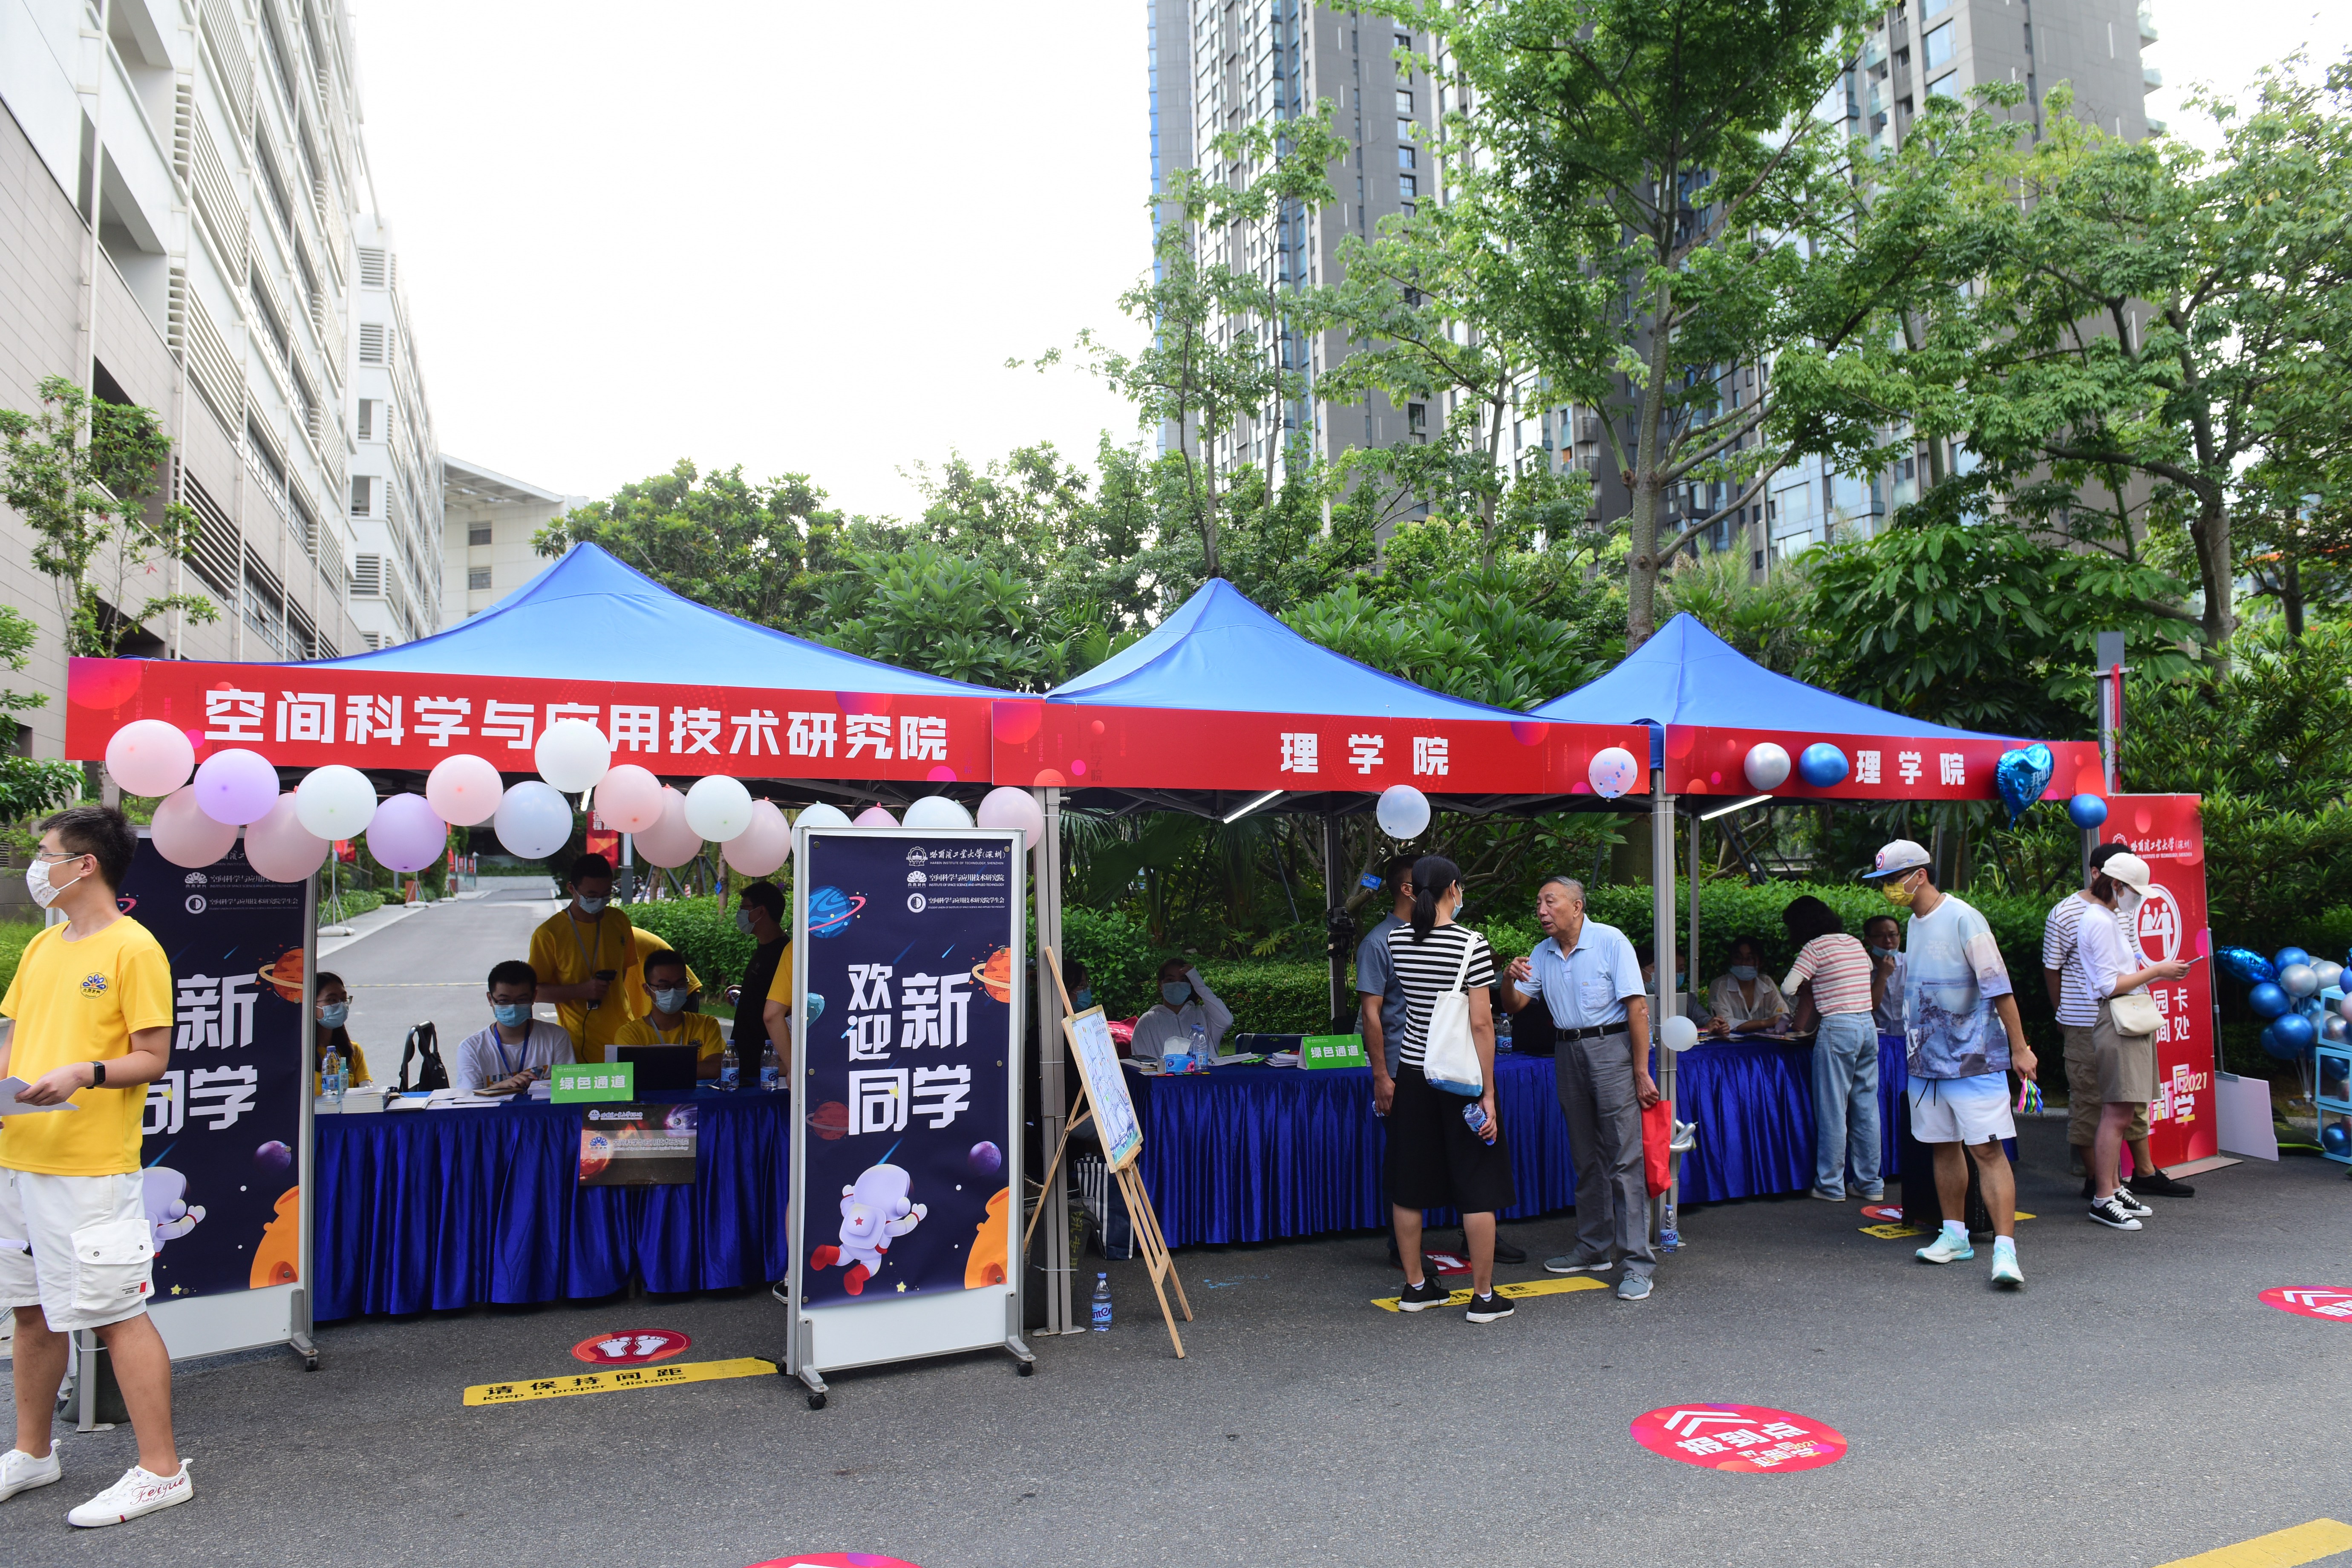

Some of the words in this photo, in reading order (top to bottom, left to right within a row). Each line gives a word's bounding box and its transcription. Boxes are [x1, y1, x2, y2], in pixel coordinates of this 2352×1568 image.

[1280, 732, 1449, 775] 理学院
[1856, 750, 1965, 785] 理学院
[929, 873, 1005, 882] 空间科学与应用技术研究院
[2153, 987, 2188, 1015] 园卡
[1310, 1045, 1359, 1058] 绿色通道
[559, 1075, 626, 1090] 绿色通道
[2181, 1072, 2208, 1094] 2021
[848, 1064, 971, 1136] 同学
[483, 1392, 525, 1401] Keep
[553, 1384, 607, 1396] proper
[620, 1375, 687, 1387] distance
[486, 1367, 684, 1395] 请保持间距
[1675, 1421, 1810, 1456] 报到点
[1792, 1440, 1819, 1450] 2021
[130, 1474, 186, 1505] Feiyue
